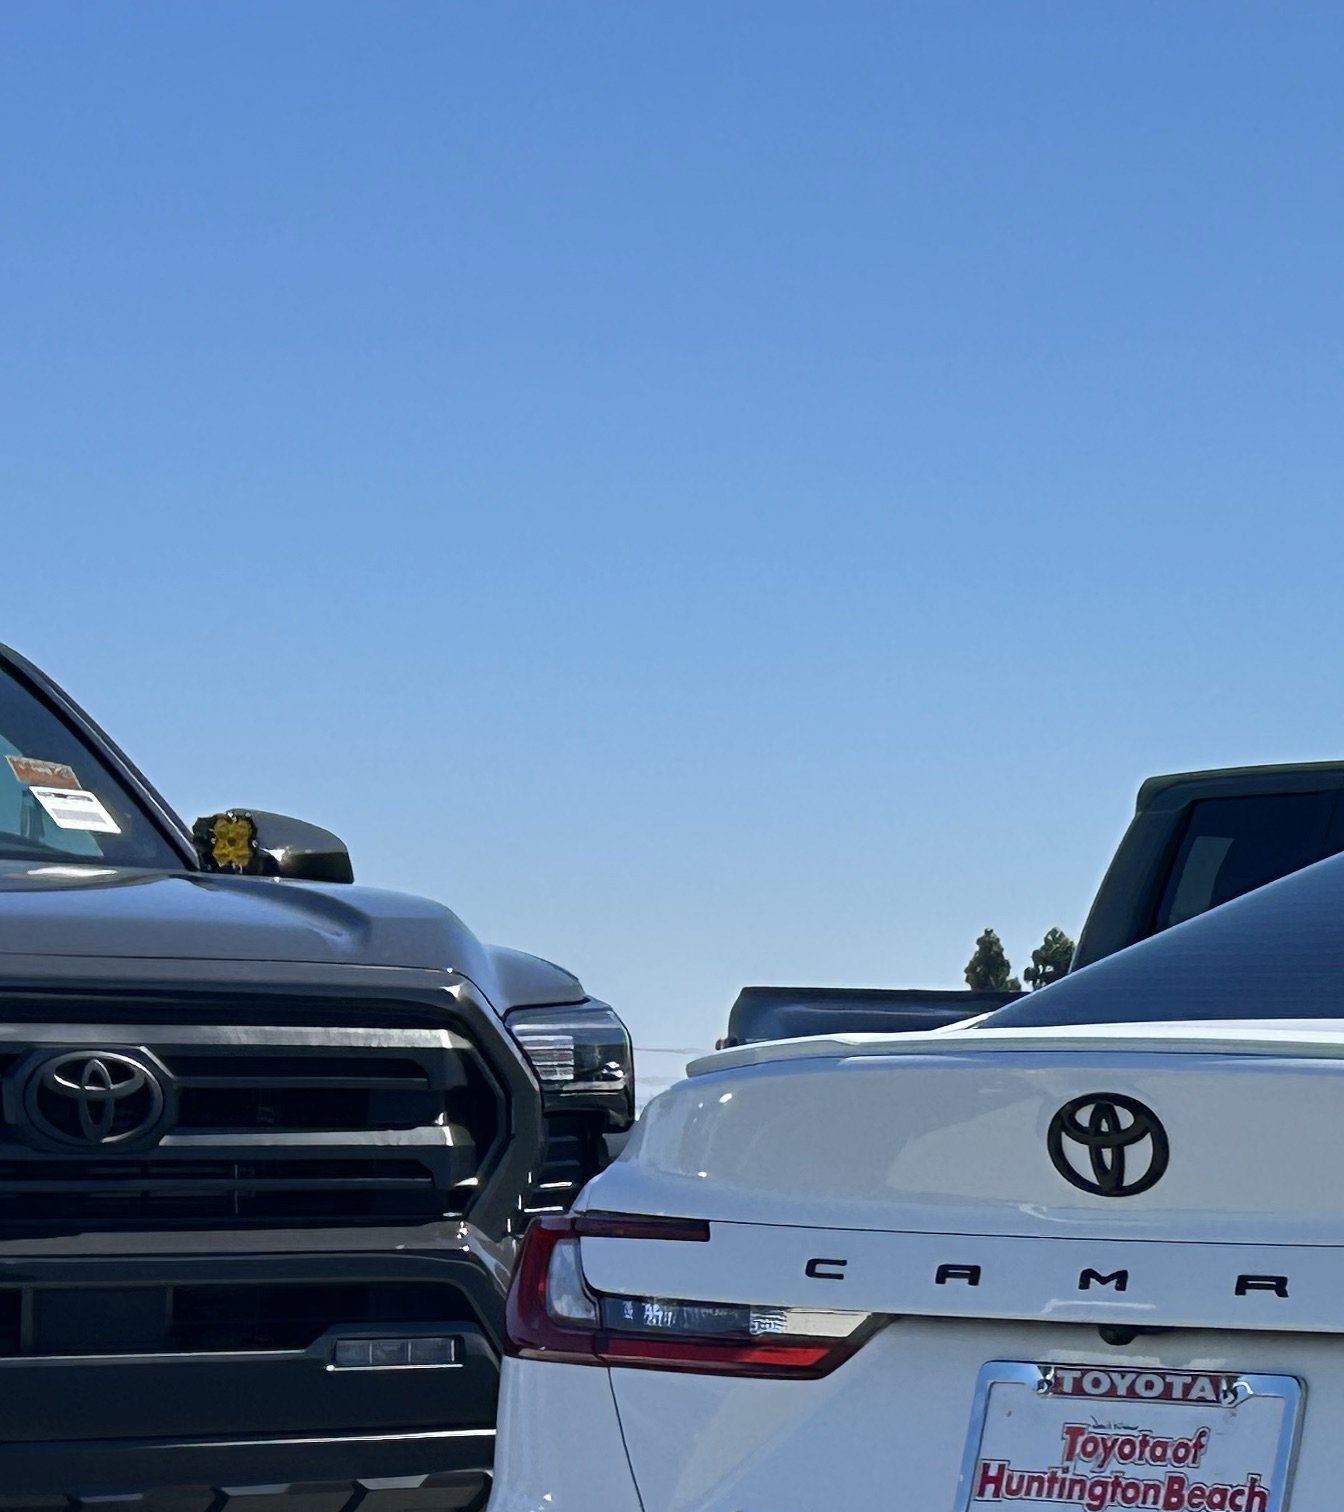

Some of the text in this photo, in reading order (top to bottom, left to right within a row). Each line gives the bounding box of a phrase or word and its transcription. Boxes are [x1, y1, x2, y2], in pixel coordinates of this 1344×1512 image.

[1056, 1368, 1220, 1401] TOYOTA
[1063, 1423, 1210, 1472] Toyota of
